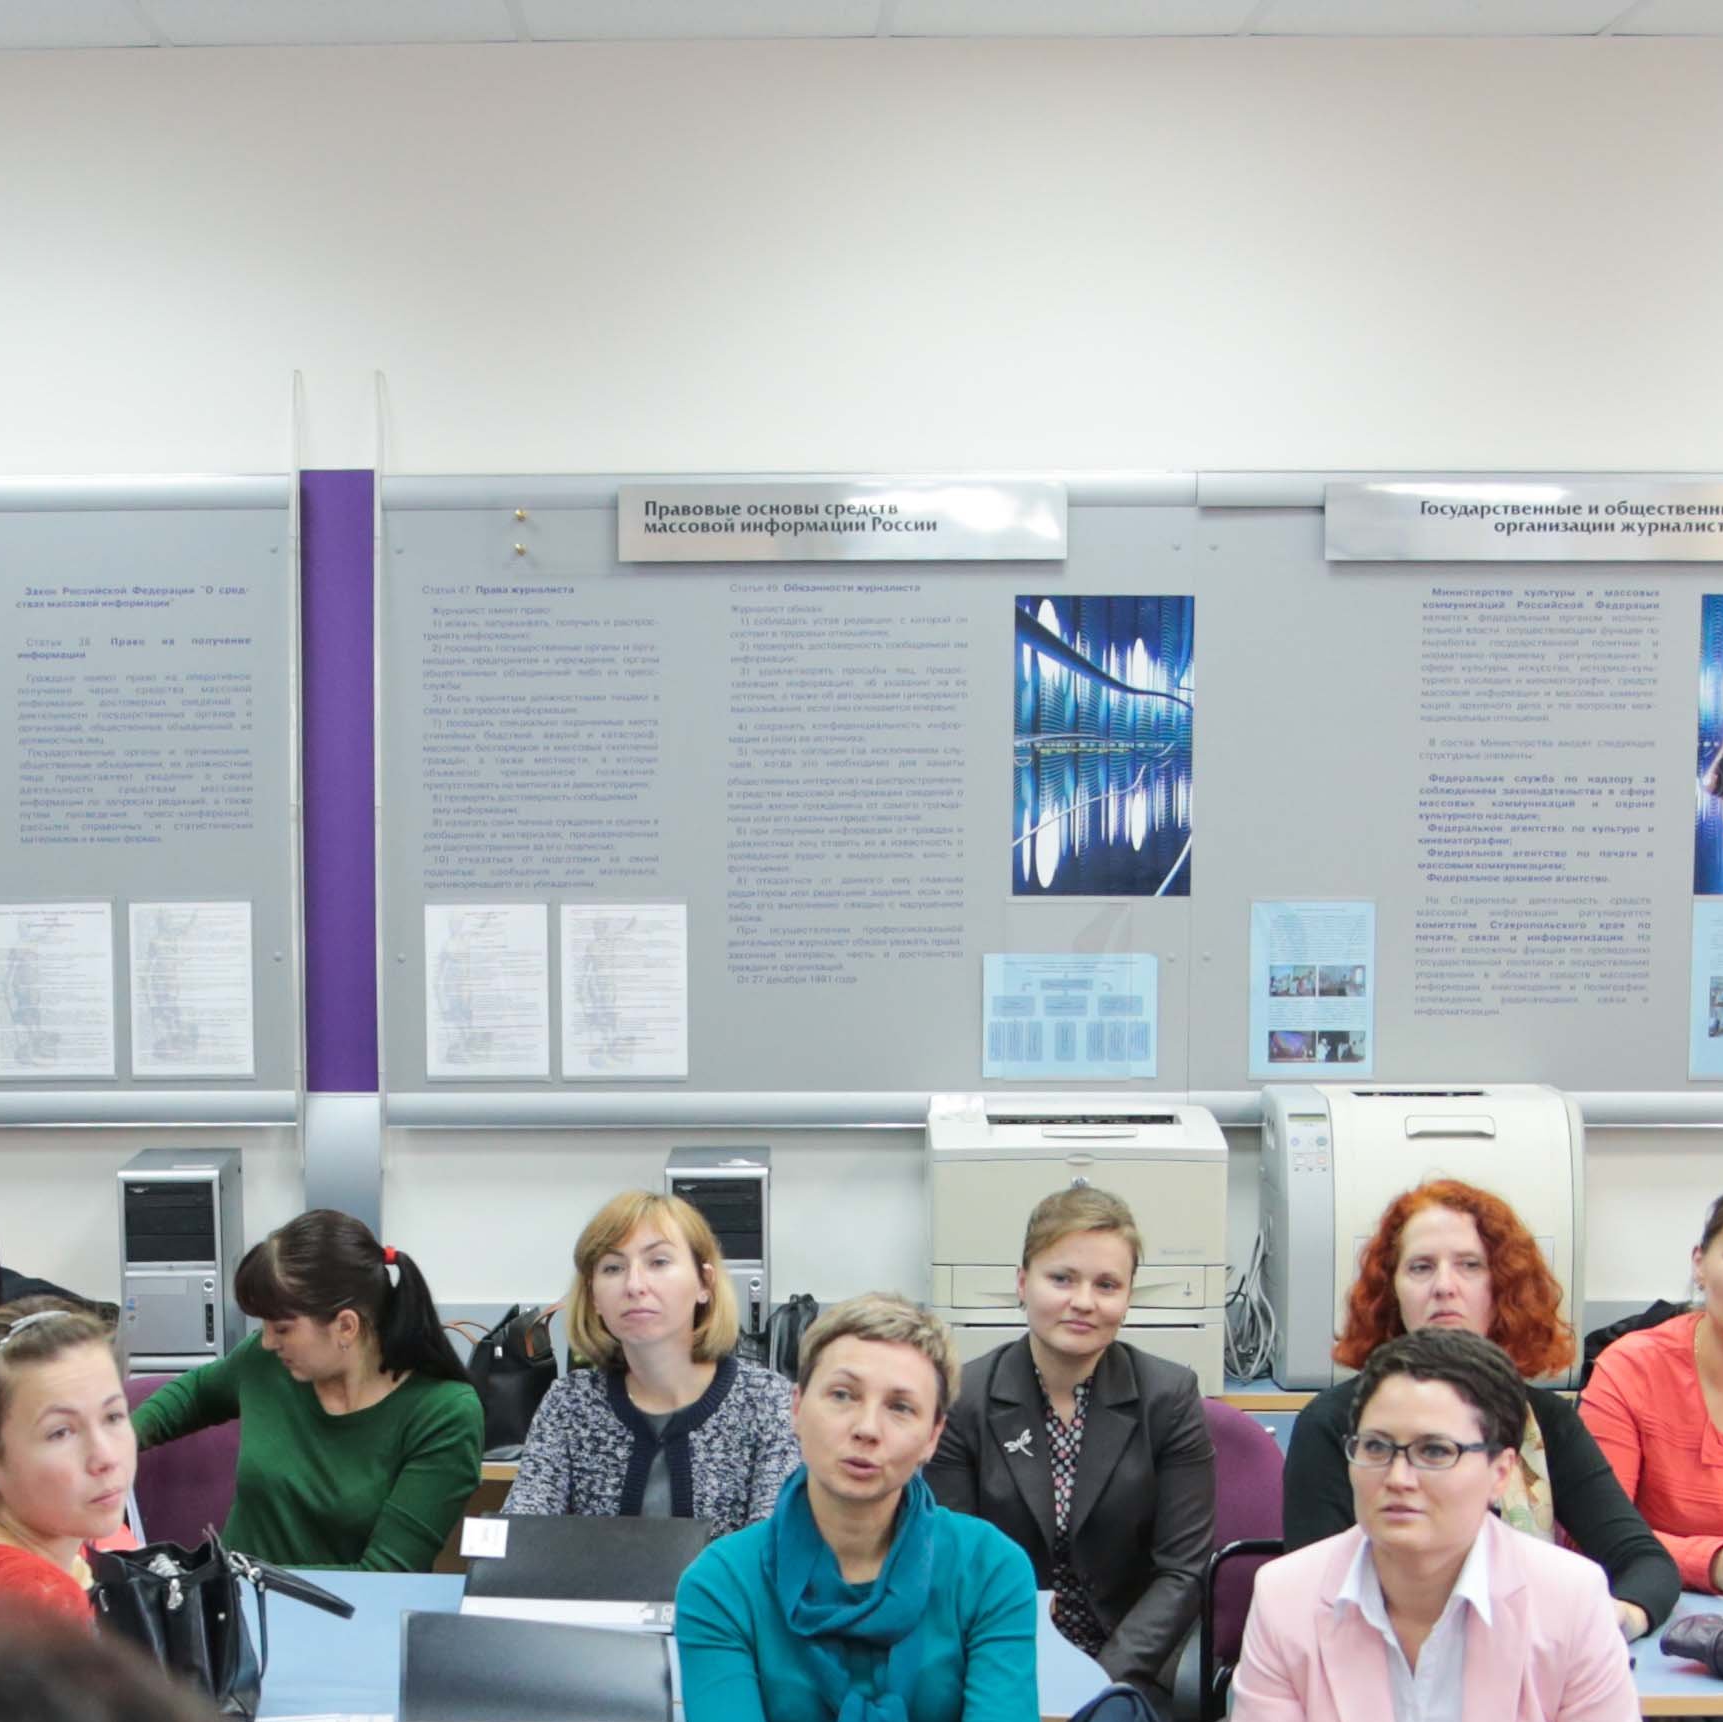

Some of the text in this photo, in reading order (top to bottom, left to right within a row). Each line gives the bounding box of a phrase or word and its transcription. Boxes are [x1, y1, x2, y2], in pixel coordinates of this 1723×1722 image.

[644, 500, 899, 519] Правовые основы средств
[1420, 500, 1583, 519] Государственные
[1588, 504, 1599, 515] и
[644, 516, 938, 537] массовой информации России
[1493, 519, 1616, 536] организации
